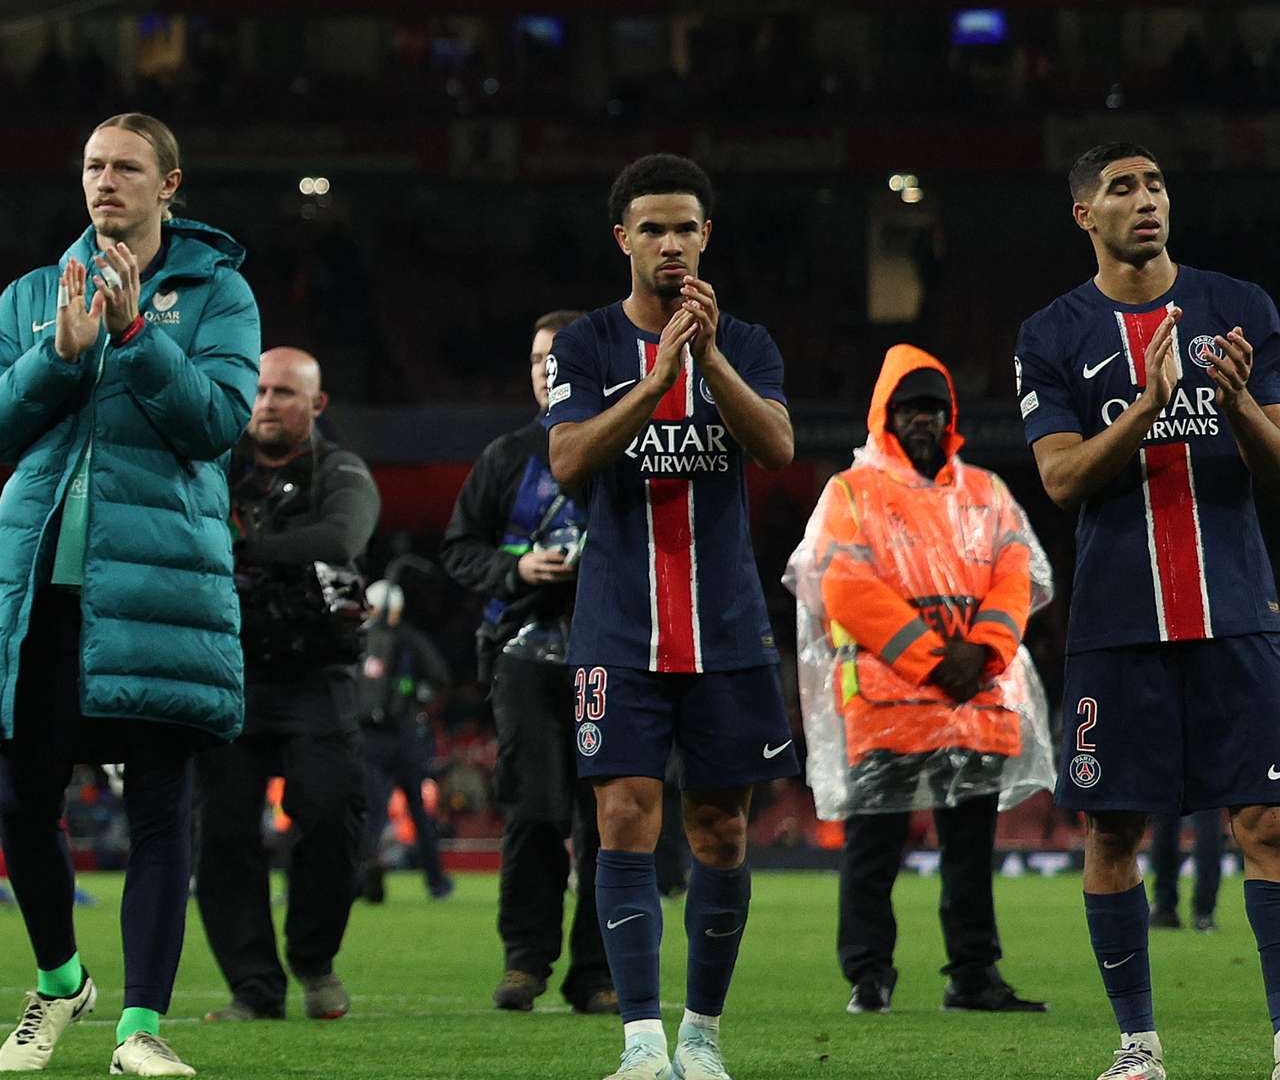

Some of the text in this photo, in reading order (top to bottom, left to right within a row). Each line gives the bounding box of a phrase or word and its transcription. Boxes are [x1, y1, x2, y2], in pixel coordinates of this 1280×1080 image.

[143, 311, 180, 322] QATAR
[1101, 387, 1218, 427] QAR
[1143, 418, 1219, 440] IRWAYS
[640, 454, 729, 473] AIRWAYS
[575, 666, 608, 722] 33
[1077, 697, 1097, 752] 2
